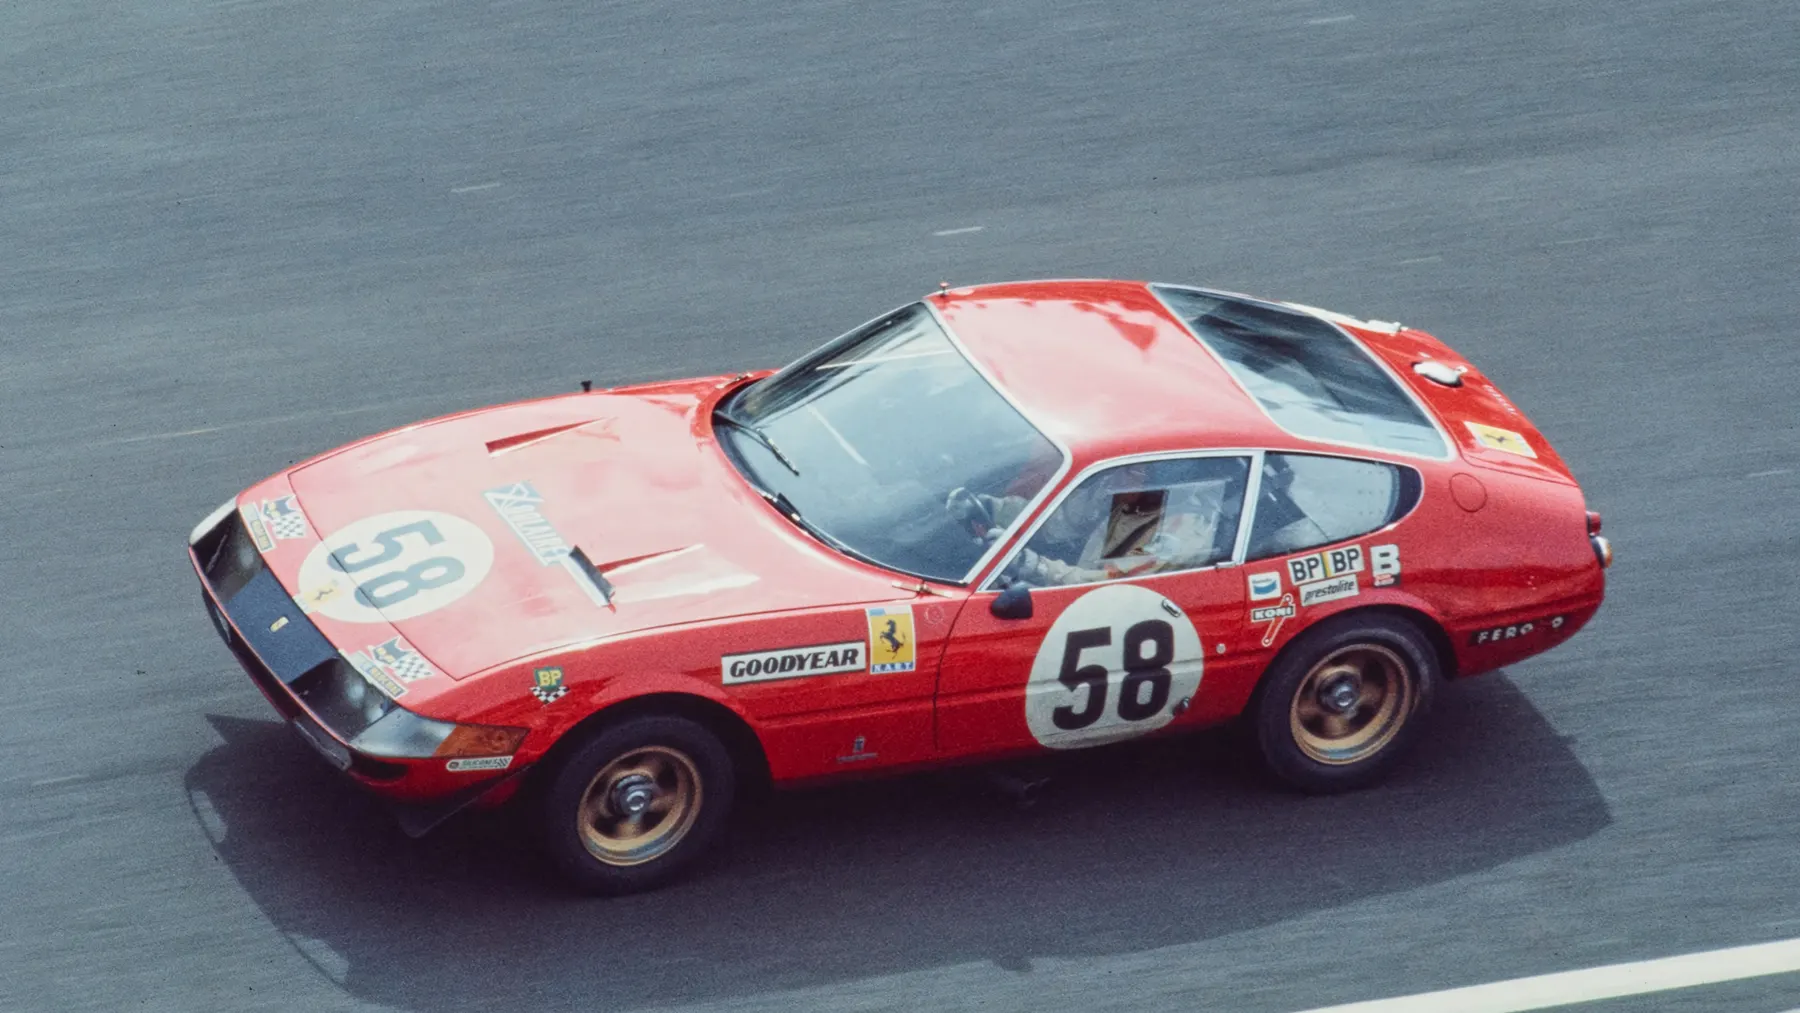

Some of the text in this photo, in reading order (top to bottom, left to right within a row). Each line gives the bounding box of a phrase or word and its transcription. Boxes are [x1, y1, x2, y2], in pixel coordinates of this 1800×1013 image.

[327, 519, 465, 609] 58
[1290, 548, 1360, 583] BP BP
[1303, 579, 1355, 602] prestolite
[1254, 606, 1292, 619] KONI
[538, 669, 562, 687] BP
[729, 648, 859, 678] GOODYEAR
[1053, 619, 1175, 730] 58
